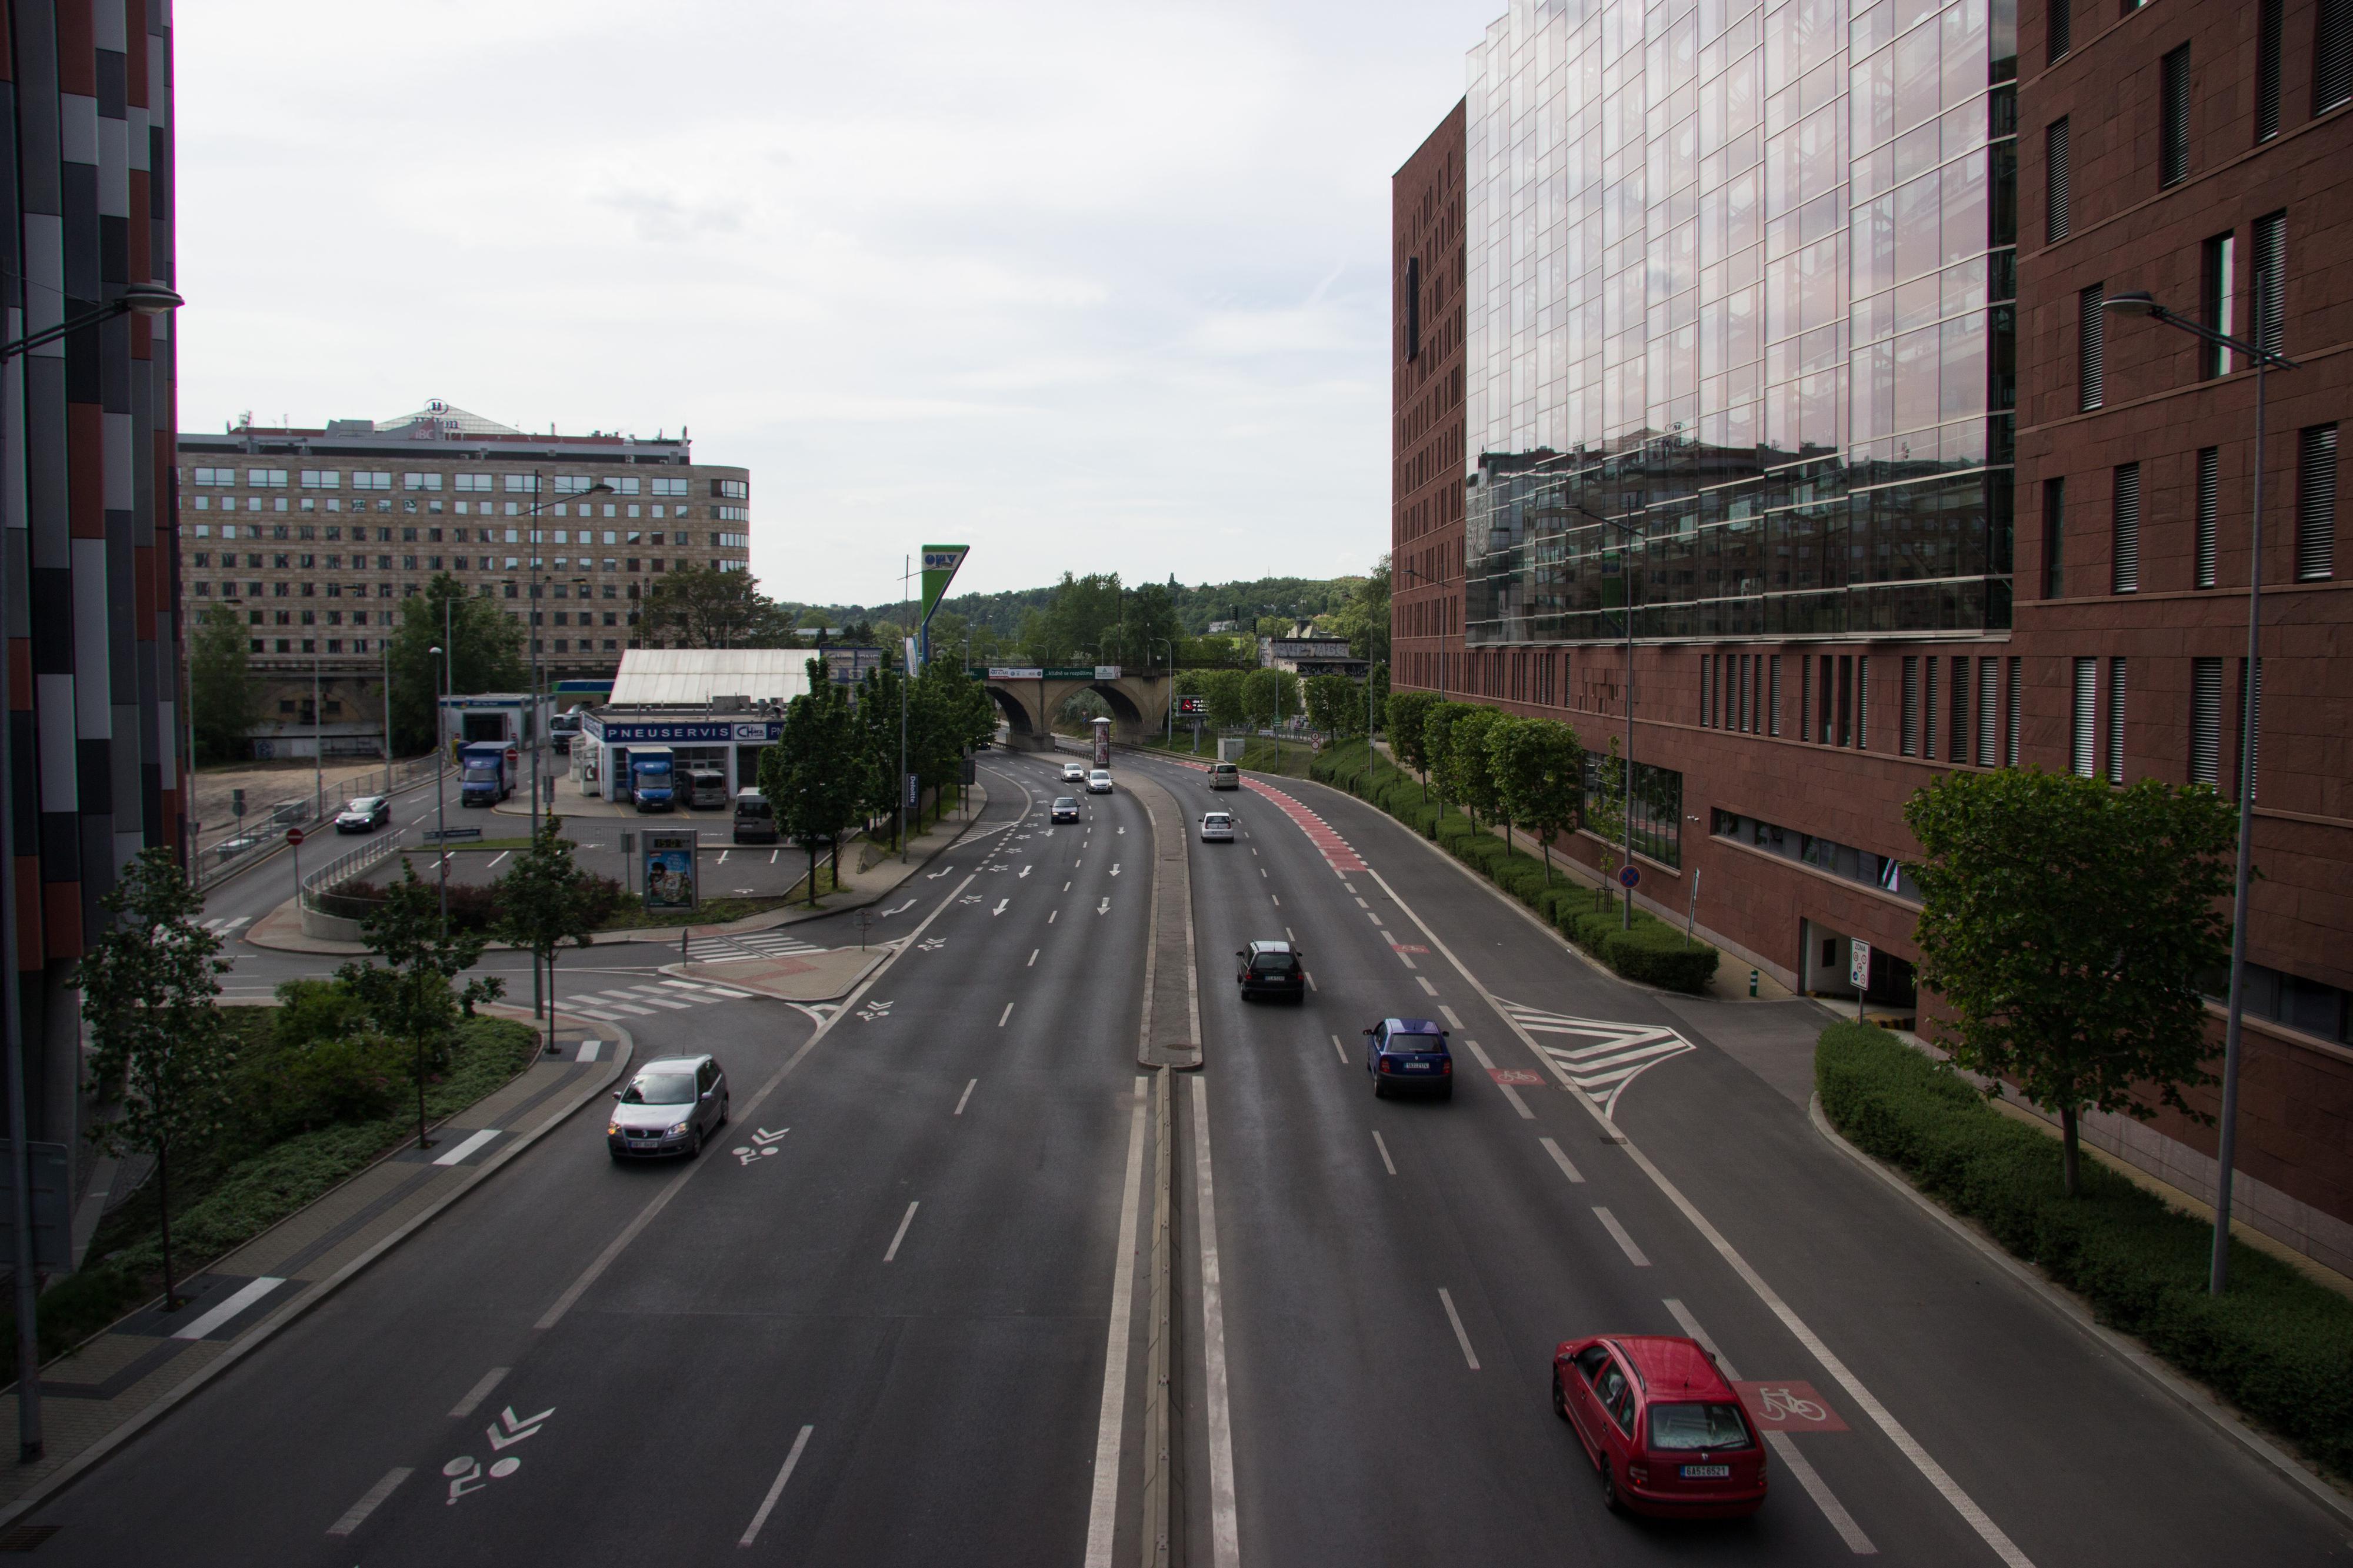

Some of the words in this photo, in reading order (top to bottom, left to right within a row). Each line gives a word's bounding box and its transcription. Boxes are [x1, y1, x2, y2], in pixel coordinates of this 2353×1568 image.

[925, 554, 958, 566] OMV
[608, 728, 729, 738] PNEUSERVIS
[1855, 943, 1866, 952] ZONA
